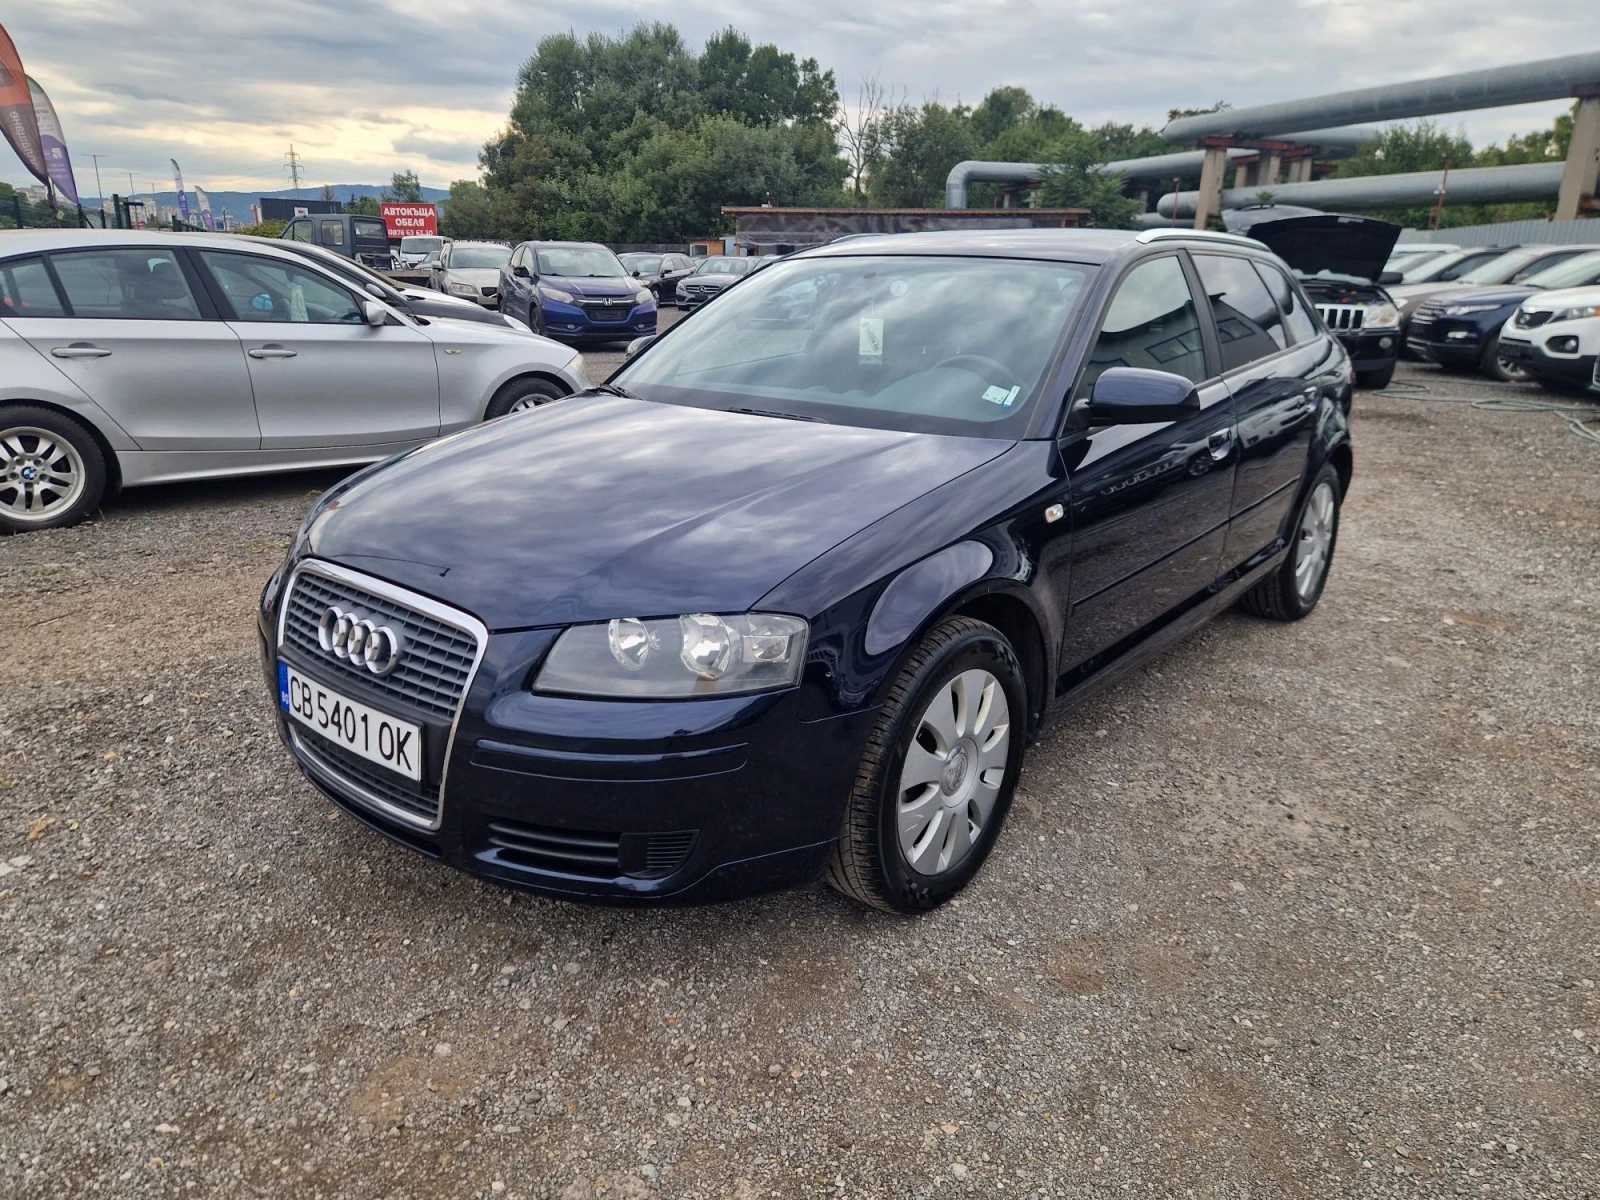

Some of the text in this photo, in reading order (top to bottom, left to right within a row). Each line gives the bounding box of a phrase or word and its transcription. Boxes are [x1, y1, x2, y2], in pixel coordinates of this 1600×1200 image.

[384, 207, 434, 217] АВТОКЪЩА
[395, 218, 424, 226] ОБЕЛЯ
[317, 690, 369, 752] 5401
[379, 721, 412, 771] OK
